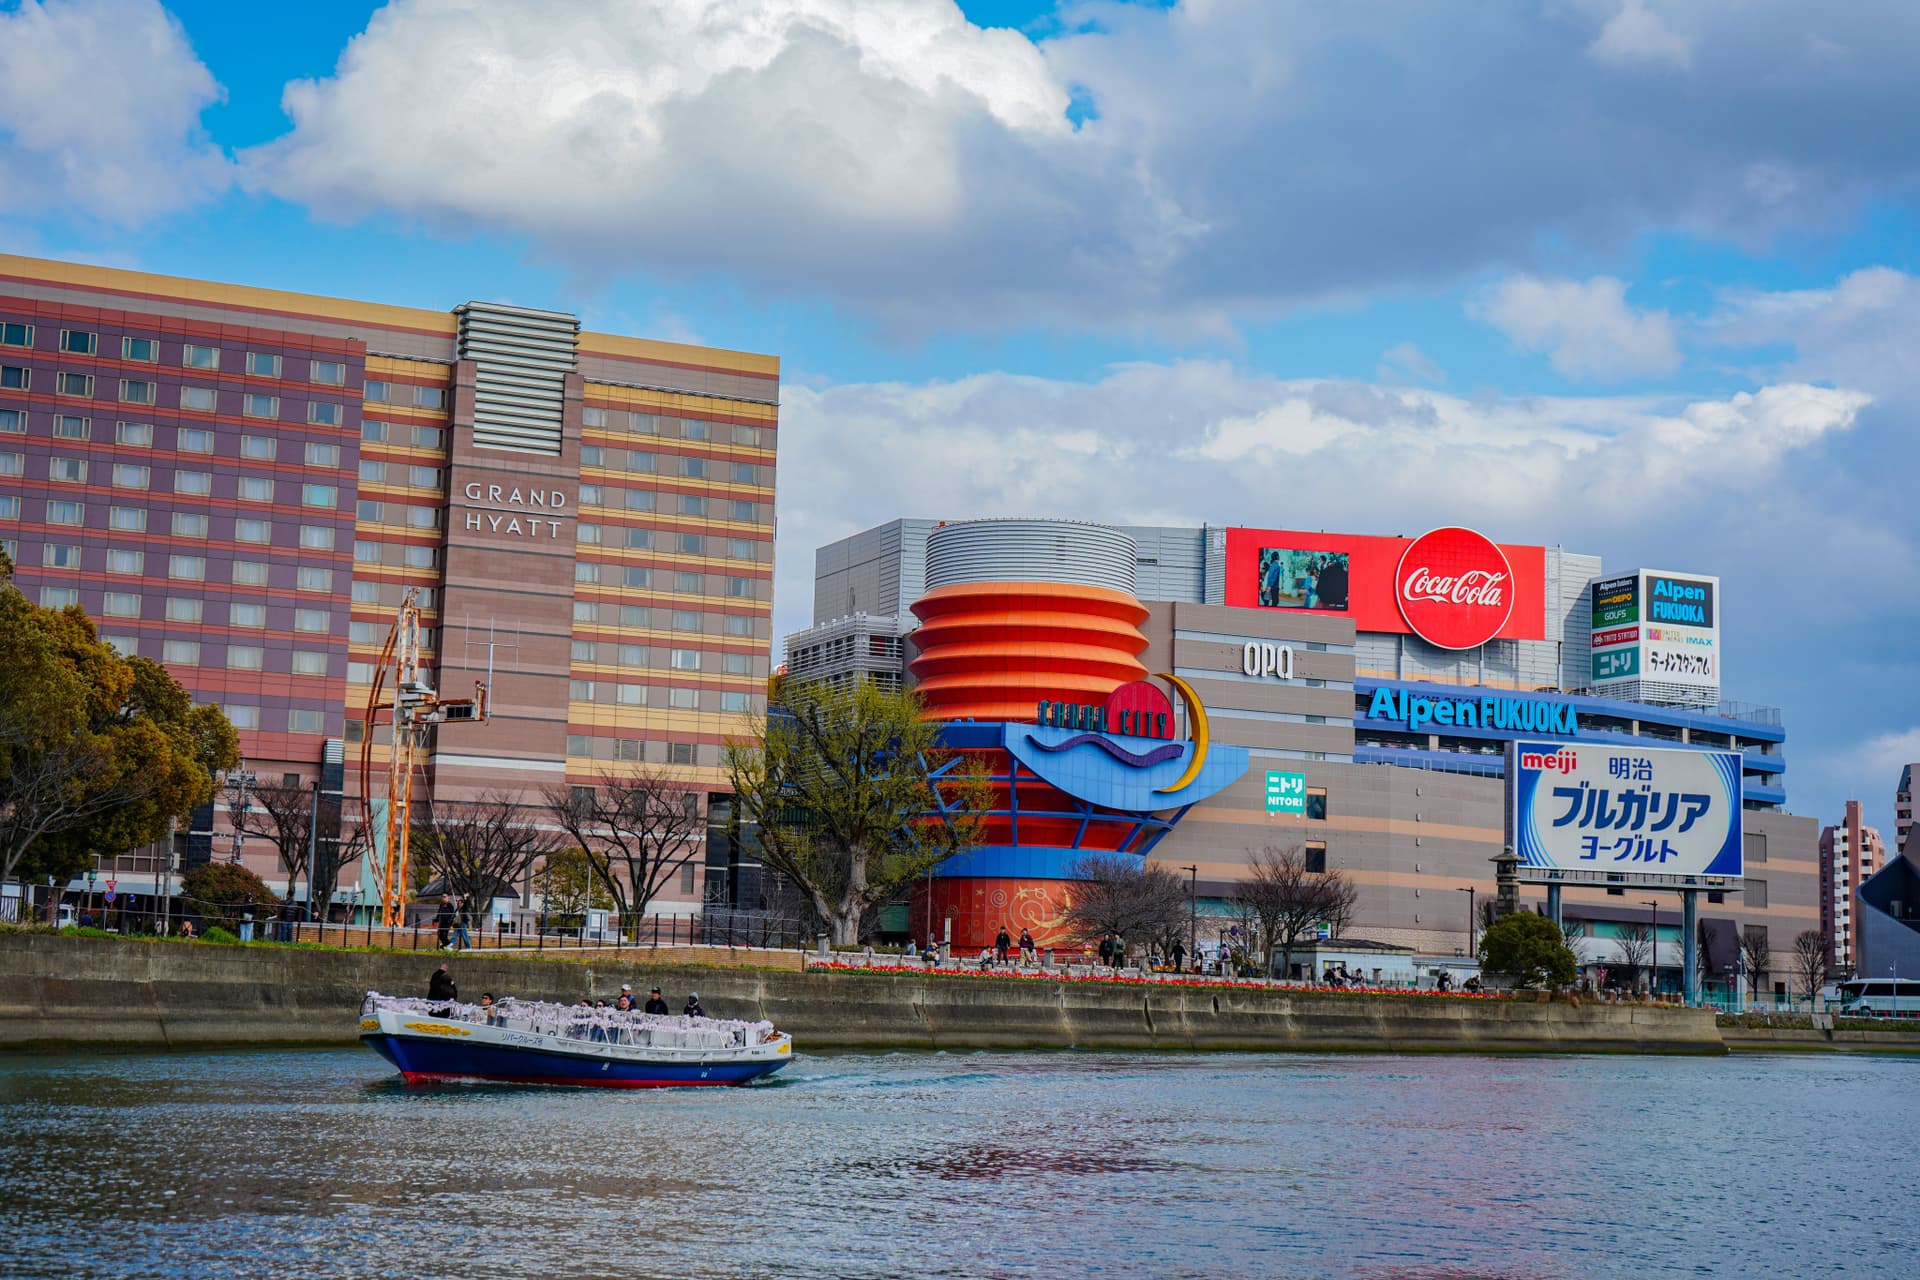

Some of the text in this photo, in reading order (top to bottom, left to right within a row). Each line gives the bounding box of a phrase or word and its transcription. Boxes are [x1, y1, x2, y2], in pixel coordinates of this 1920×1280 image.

[465, 482, 565, 508] GRAND
[465, 512, 562, 538] HYATT
[1403, 567, 1508, 606] Coca-Cola
[1653, 579, 1705, 601] Alpen
[1653, 601, 1704, 623] FUKUOKA
[1686, 636, 1713, 647] IMAX
[1600, 651, 1632, 676] ニトリ
[1038, 699, 1167, 737] CANAL CITY
[1368, 687, 1579, 735] Alpen FUKUOKA
[1523, 751, 1577, 775] meiji
[1609, 757, 1653, 781] 明治
[1268, 776, 1303, 794] ニトリ
[1268, 796, 1303, 807] NITORI
[1552, 781, 1711, 833] ブルガリア
[1580, 834, 1678, 863] ヨーグルト
